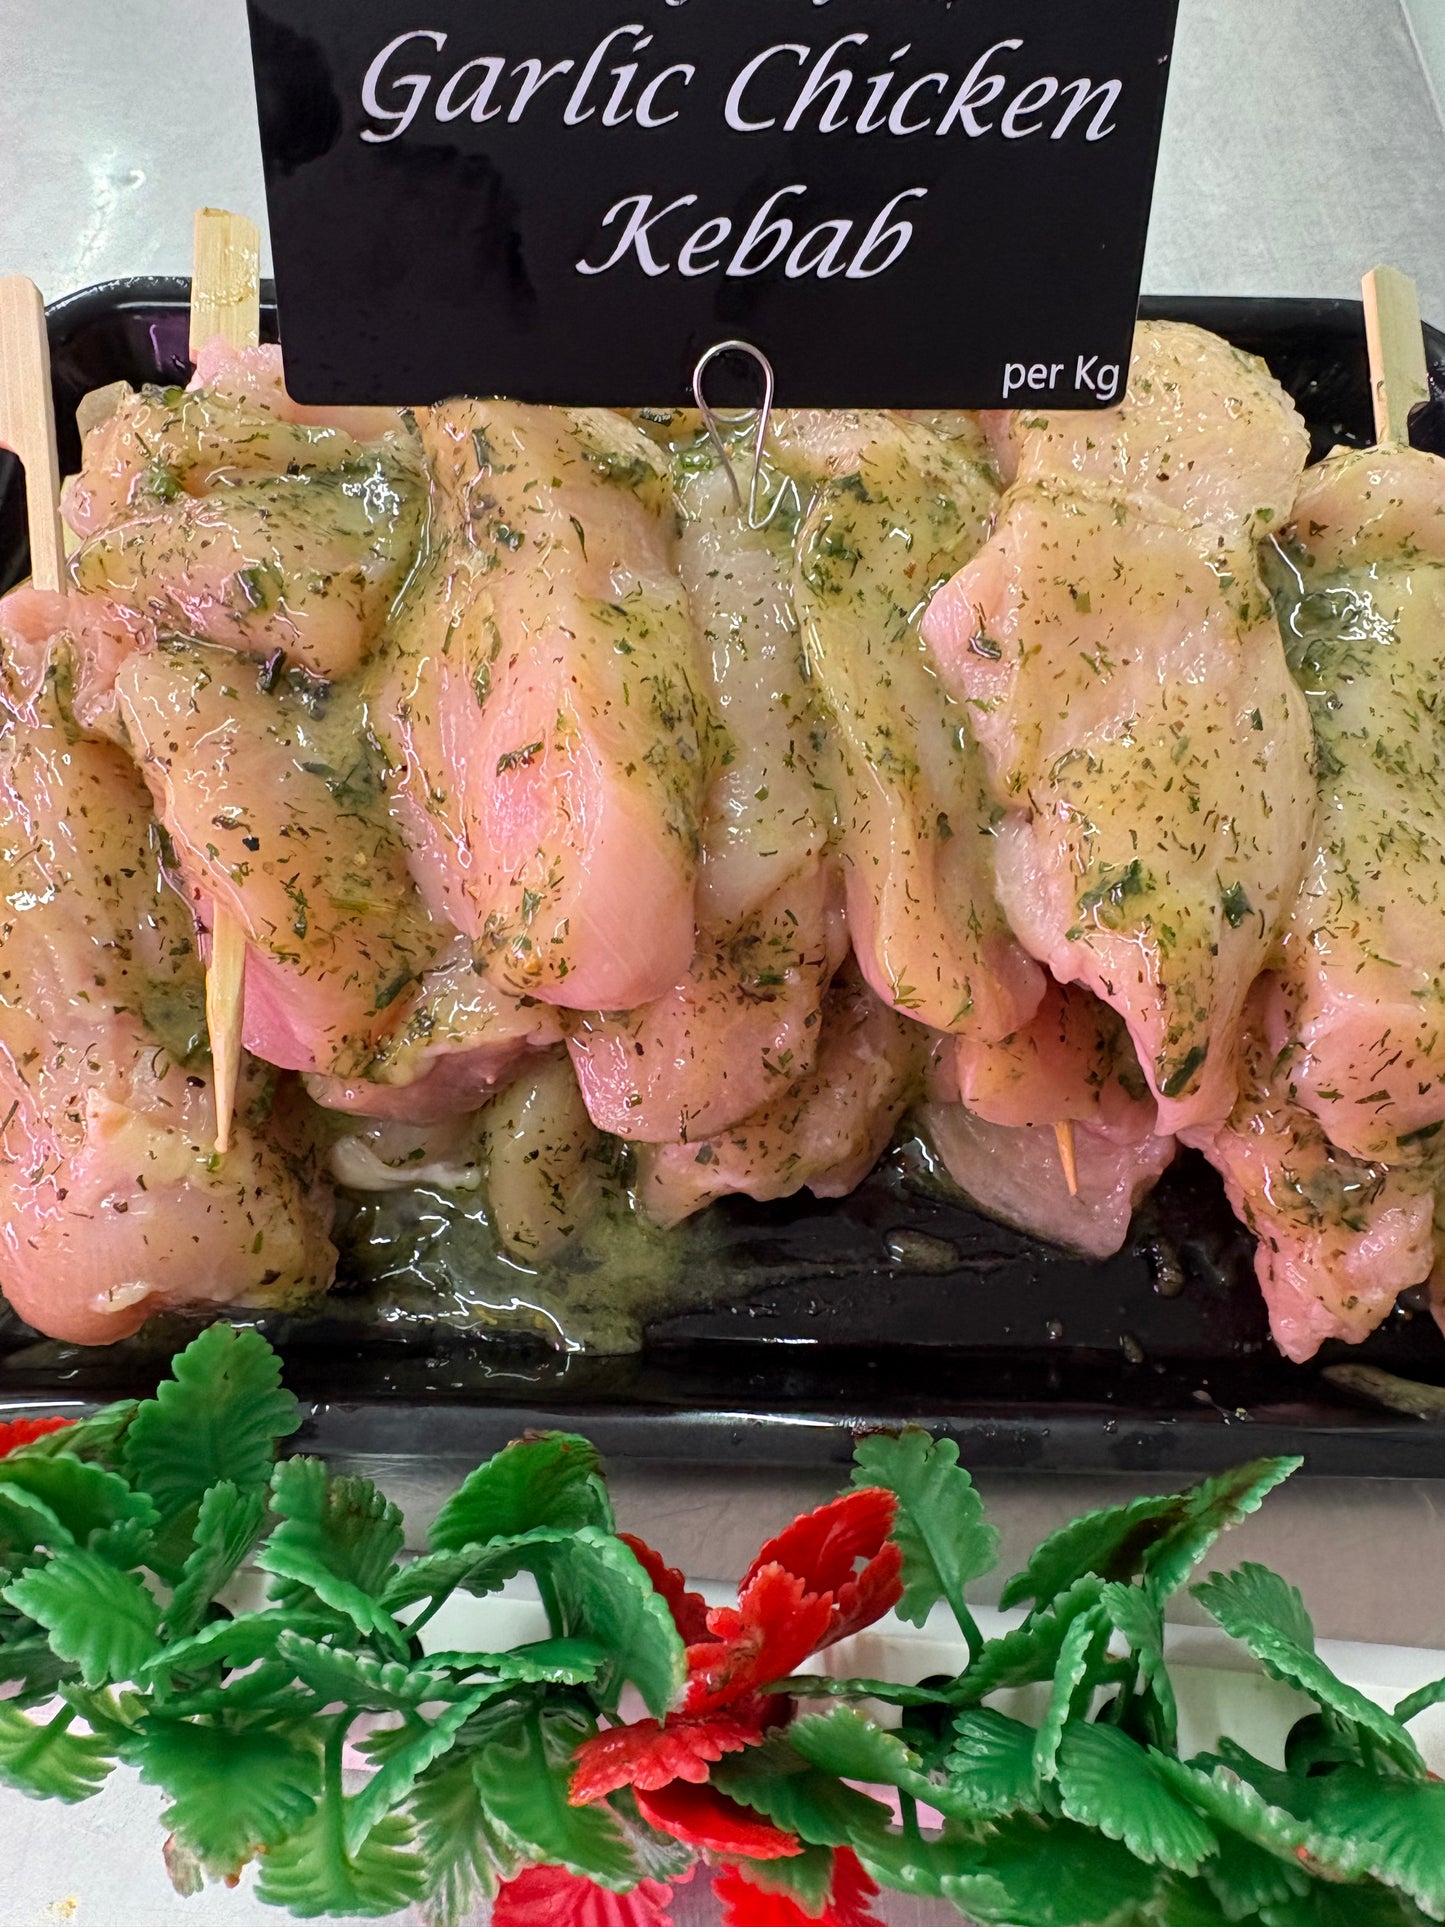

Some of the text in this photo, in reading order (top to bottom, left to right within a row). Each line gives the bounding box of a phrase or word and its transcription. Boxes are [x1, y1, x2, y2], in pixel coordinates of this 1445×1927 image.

[361, 25, 1123, 142] Garlic Chicken
[576, 185, 928, 278] Kebab
[1002, 355, 1120, 401] per Kg
